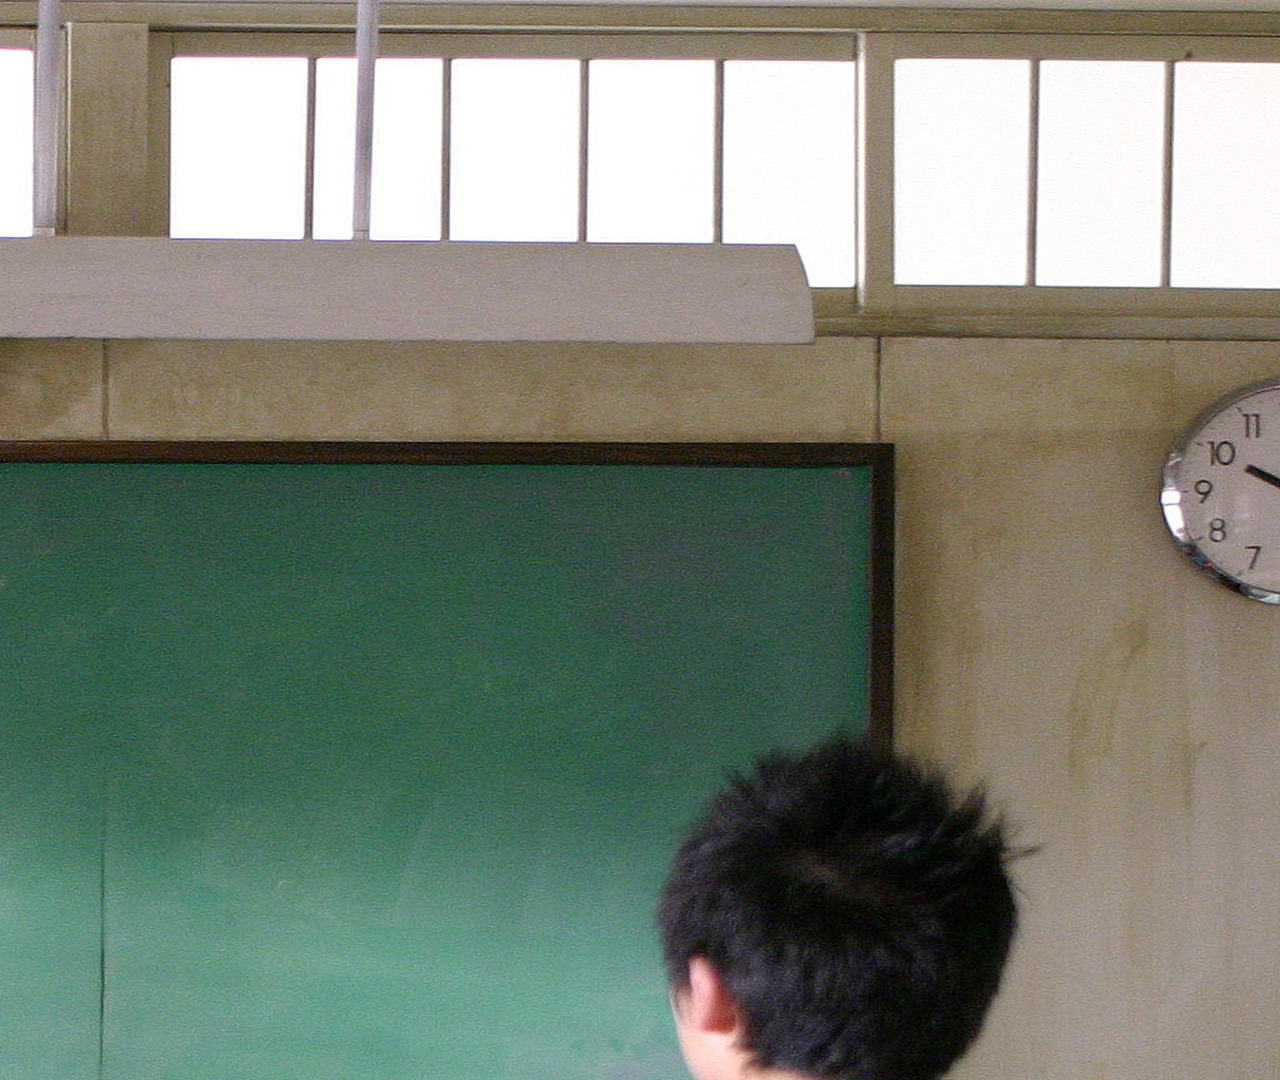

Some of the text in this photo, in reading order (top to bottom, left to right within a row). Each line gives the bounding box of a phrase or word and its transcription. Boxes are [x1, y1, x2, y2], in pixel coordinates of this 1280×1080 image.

[1242, 413, 1260, 438] 11
[1209, 440, 1236, 466] 10
[1194, 479, 1213, 503] 9
[1209, 518, 1226, 543] 8
[1245, 545, 1261, 570] 7
